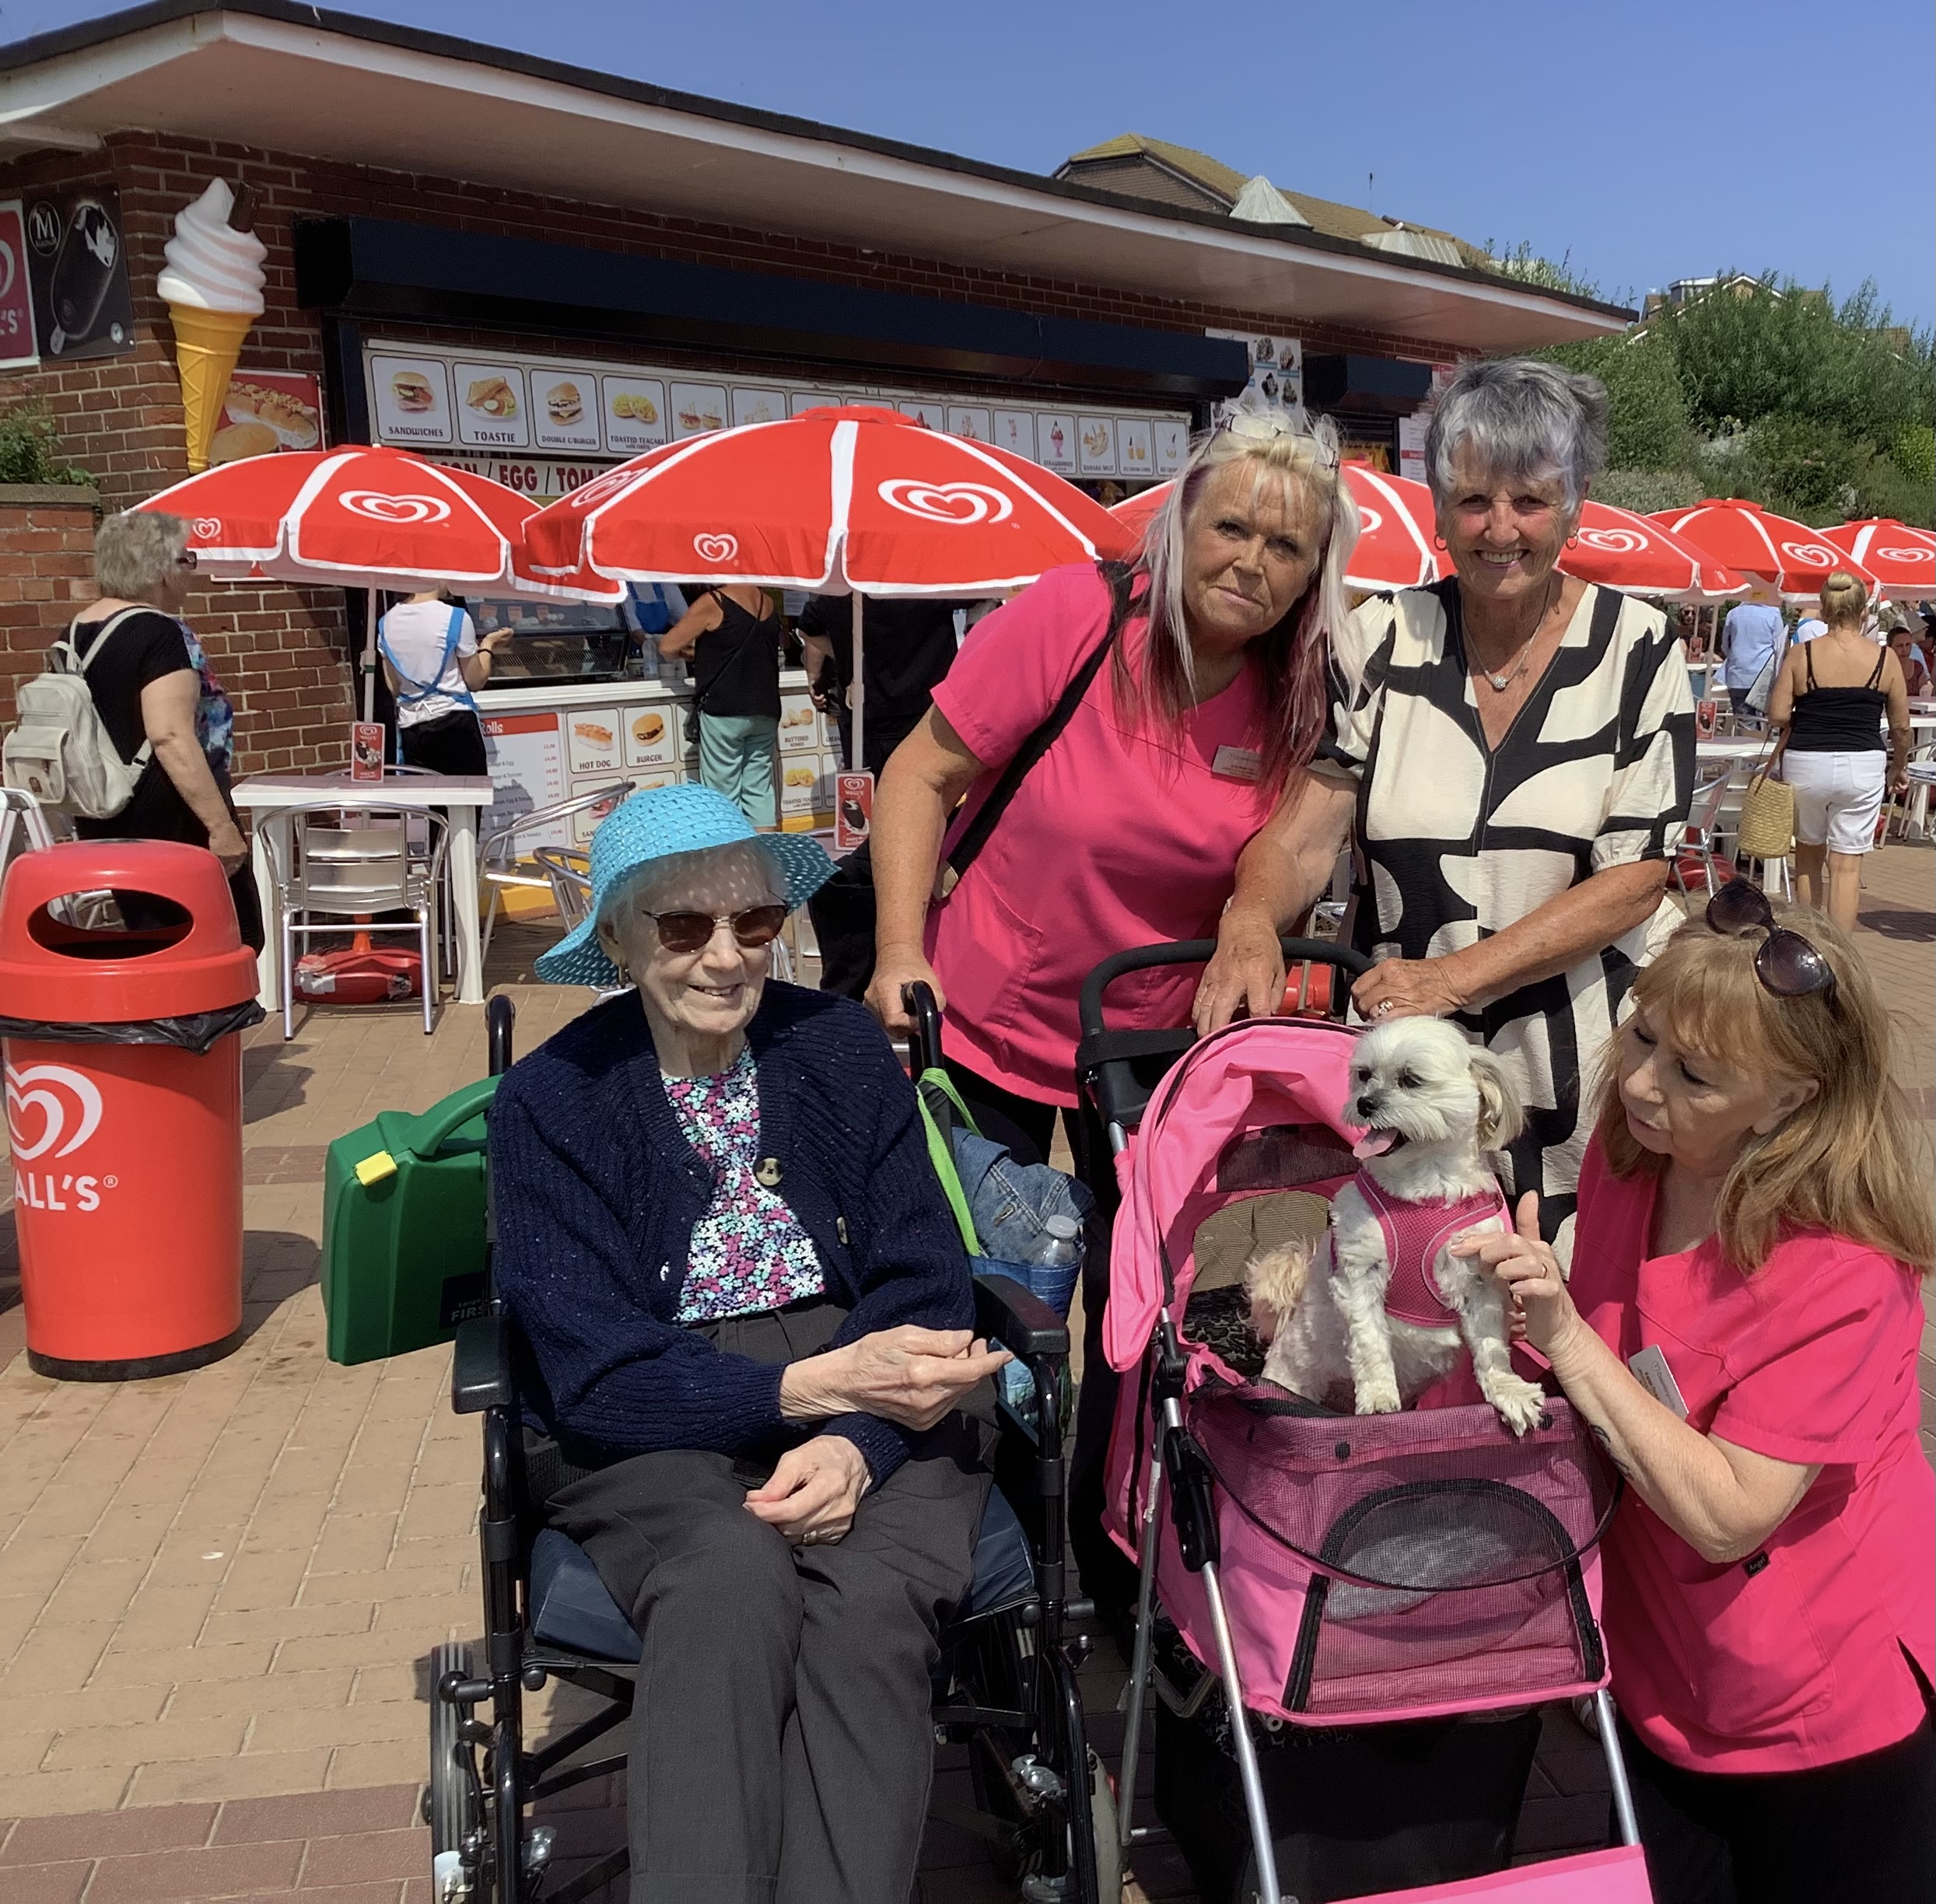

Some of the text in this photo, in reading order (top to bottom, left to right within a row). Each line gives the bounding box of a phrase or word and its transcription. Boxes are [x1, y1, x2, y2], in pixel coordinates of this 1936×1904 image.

[388, 426, 443, 436] SANDWICHES
[473, 431, 516, 443] TOASTIE
[568, 436, 597, 445] C/BURGER
[499, 465, 537, 492] EGG
[636, 754, 662, 763] BURGER
[579, 760, 611, 770] HOT DOG
[450, 1305, 485, 1322] FIRS
